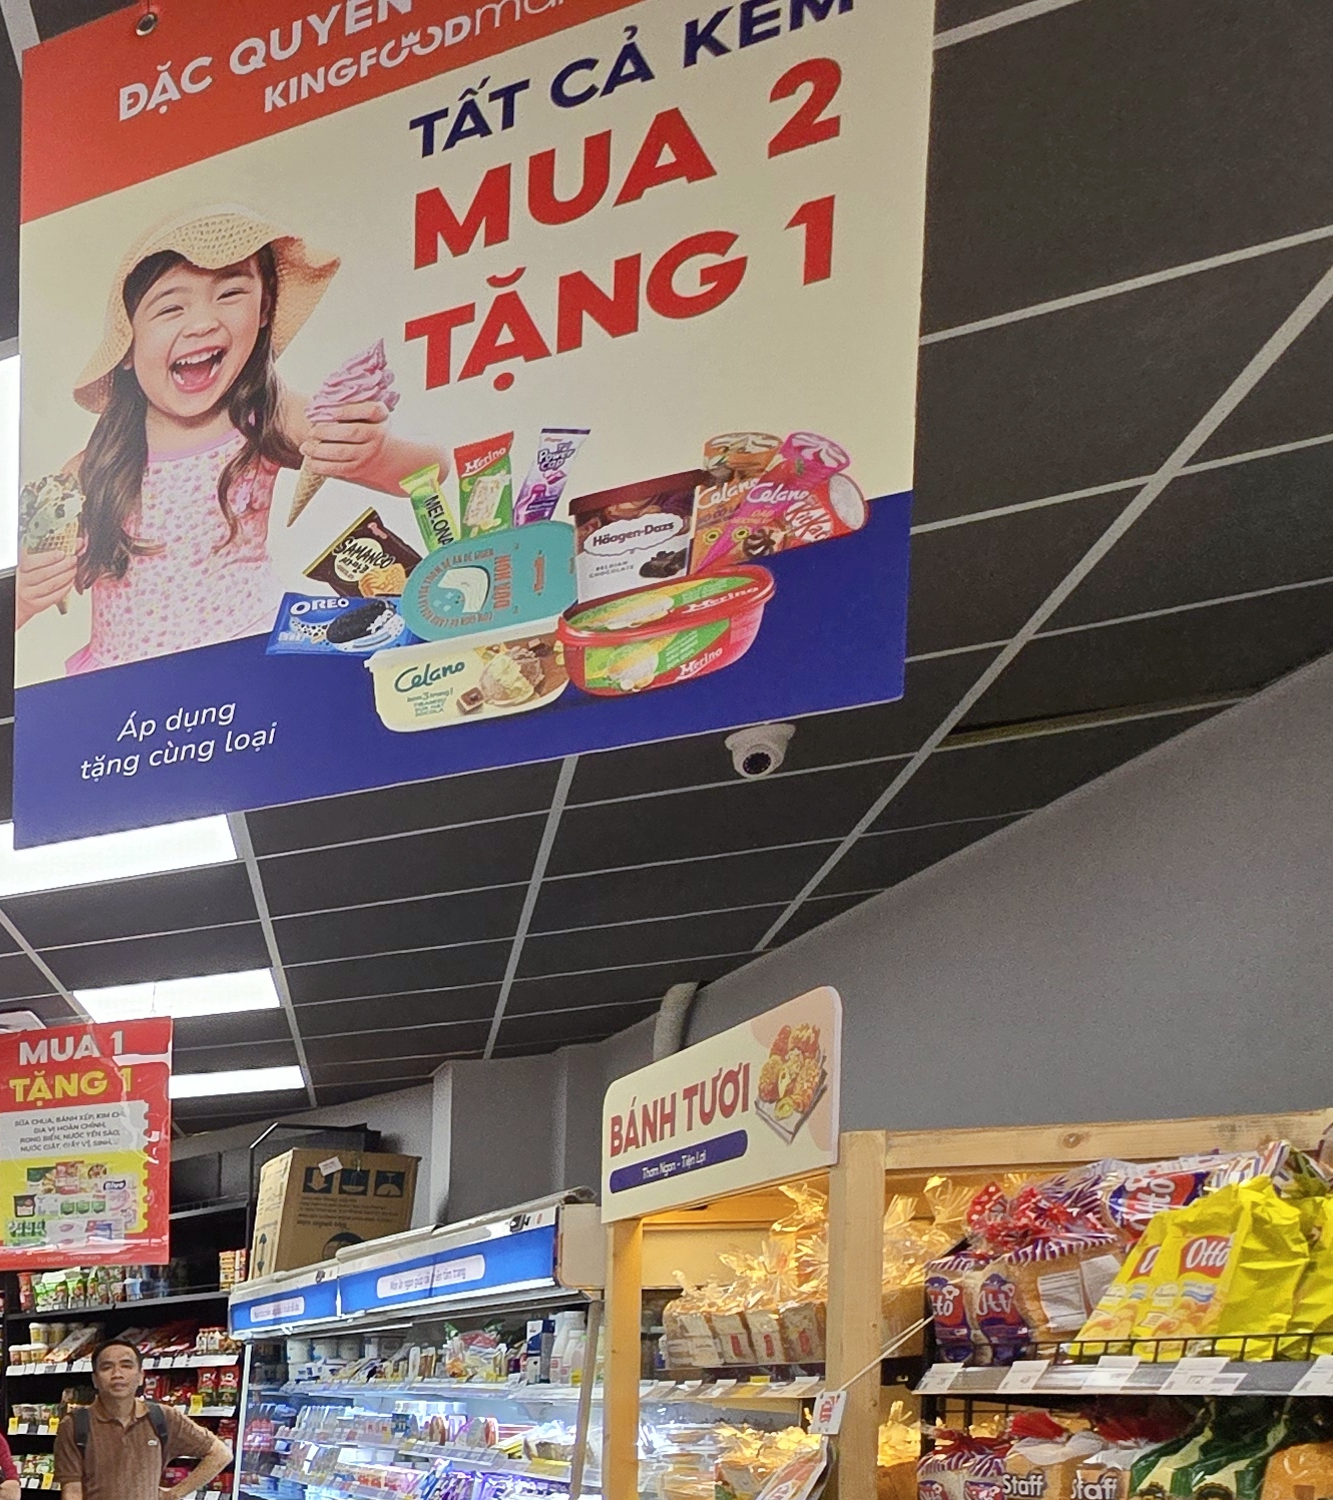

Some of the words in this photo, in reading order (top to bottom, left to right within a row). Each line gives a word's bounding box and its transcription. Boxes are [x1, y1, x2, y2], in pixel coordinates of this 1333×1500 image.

[118, 55, 212, 122] ĐẶC
[409, 76, 531, 158] TẤT
[550, 27, 656, 109] CẢ
[414, 106, 716, 270] MUA
[768, 57, 843, 160] 2
[404, 229, 748, 391] TẶNG
[783, 194, 836, 286] 1
[289, 597, 349, 616] OREO
[394, 660, 465, 693] Celano
[116, 712, 156, 741] Áp
[163, 698, 237, 738] dụng
[80, 745, 142, 782] tặng
[147, 732, 217, 773] cùng
[224, 721, 278, 760] loại
[19, 1034, 101, 1066] MUA
[111, 1031, 123, 1054] 1
[9, 1070, 108, 1107] TẶNG
[119, 1068, 132, 1092] 1
[610, 1096, 677, 1158] BÁNH
[683, 1062, 750, 1132] TƯƠI
[1185, 1237, 1232, 1268] Otto
